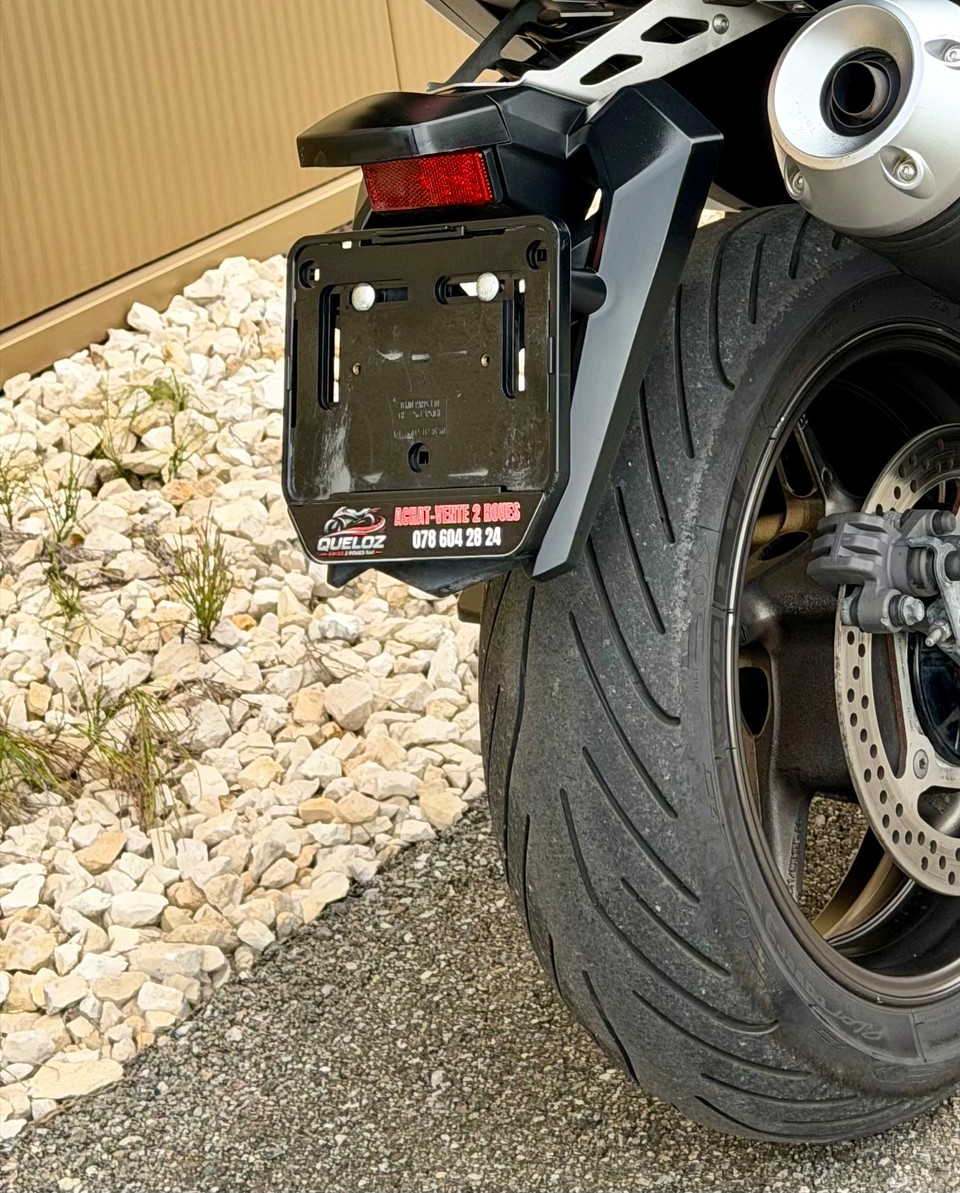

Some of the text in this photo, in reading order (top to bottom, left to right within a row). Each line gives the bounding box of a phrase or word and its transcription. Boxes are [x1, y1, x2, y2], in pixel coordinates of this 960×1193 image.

[472, 503, 481, 523] 2
[483, 501, 521, 523] ROUES
[316, 535, 387, 551] QUELOZ
[412, 526, 502, 549] 078 604 28 24
